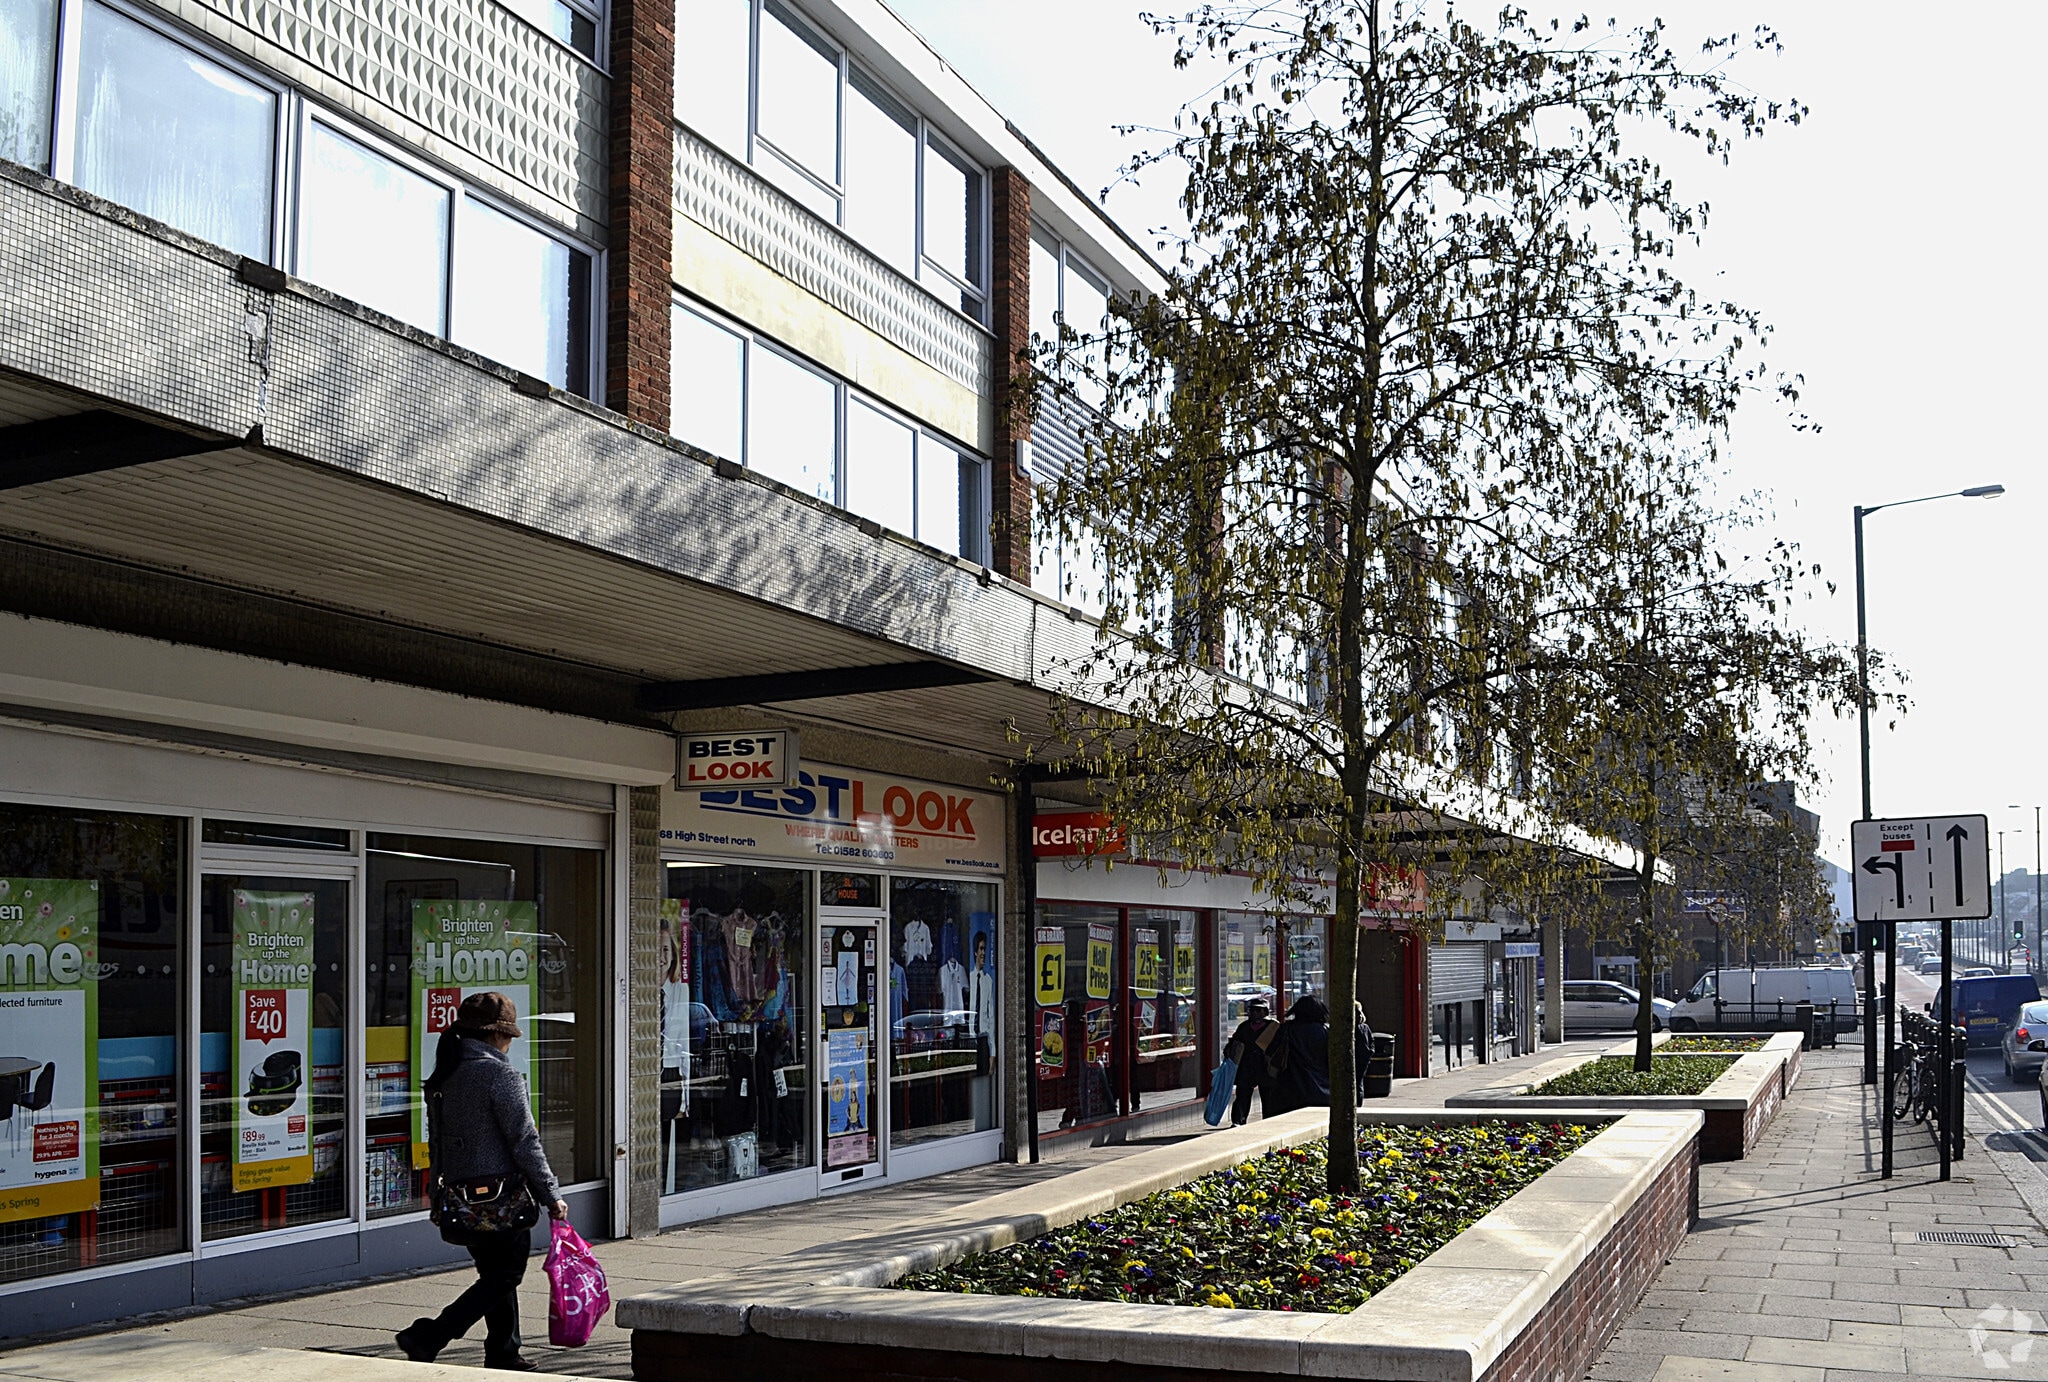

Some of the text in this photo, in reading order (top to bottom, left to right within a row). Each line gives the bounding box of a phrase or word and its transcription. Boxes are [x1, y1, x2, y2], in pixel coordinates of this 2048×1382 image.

[688, 737, 776, 758] BEST
[688, 760, 774, 781] LOOK
[785, 824, 825, 839] WHERE
[1880, 823, 1914, 831] Except
[674, 830, 696, 843] High
[698, 832, 729, 845] Street
[730, 837, 756, 847] north
[816, 844, 894, 860] Tel: 01582 603603
[945, 858, 1000, 869] www.bestlook.co.uk
[838, 889, 858, 899] HOUSE
[441, 918, 494, 936] Brighten
[247, 932, 304, 951] Brighten
[454, 935, 481, 946] up the
[262, 949, 290, 960] up the
[1092, 945, 1107, 967] Half
[426, 942, 528, 983] Home
[539, 958, 568, 974] Argos
[240, 959, 310, 984] Home
[1041, 953, 1062, 992] £1
[1090, 967, 1109, 990] Price
[27, 996, 63, 1008] furniture
[249, 995, 276, 1008] Save
[431, 992, 453, 1005] Save
[249, 1009, 283, 1034] £40
[430, 1006, 458, 1028] £30
[36, 1126, 59, 1135] Nothing
[66, 1124, 77, 1132] Pay
[53, 1132, 74, 1140] months
[242, 1130, 266, 1142] £89.99
[34, 1168, 67, 1180] hygena
[239, 1169, 257, 1177] Enjoy
[258, 1167, 274, 1176] great
[252, 1176, 272, 1184] Spring
[9, 1197, 40, 1210] Spring
